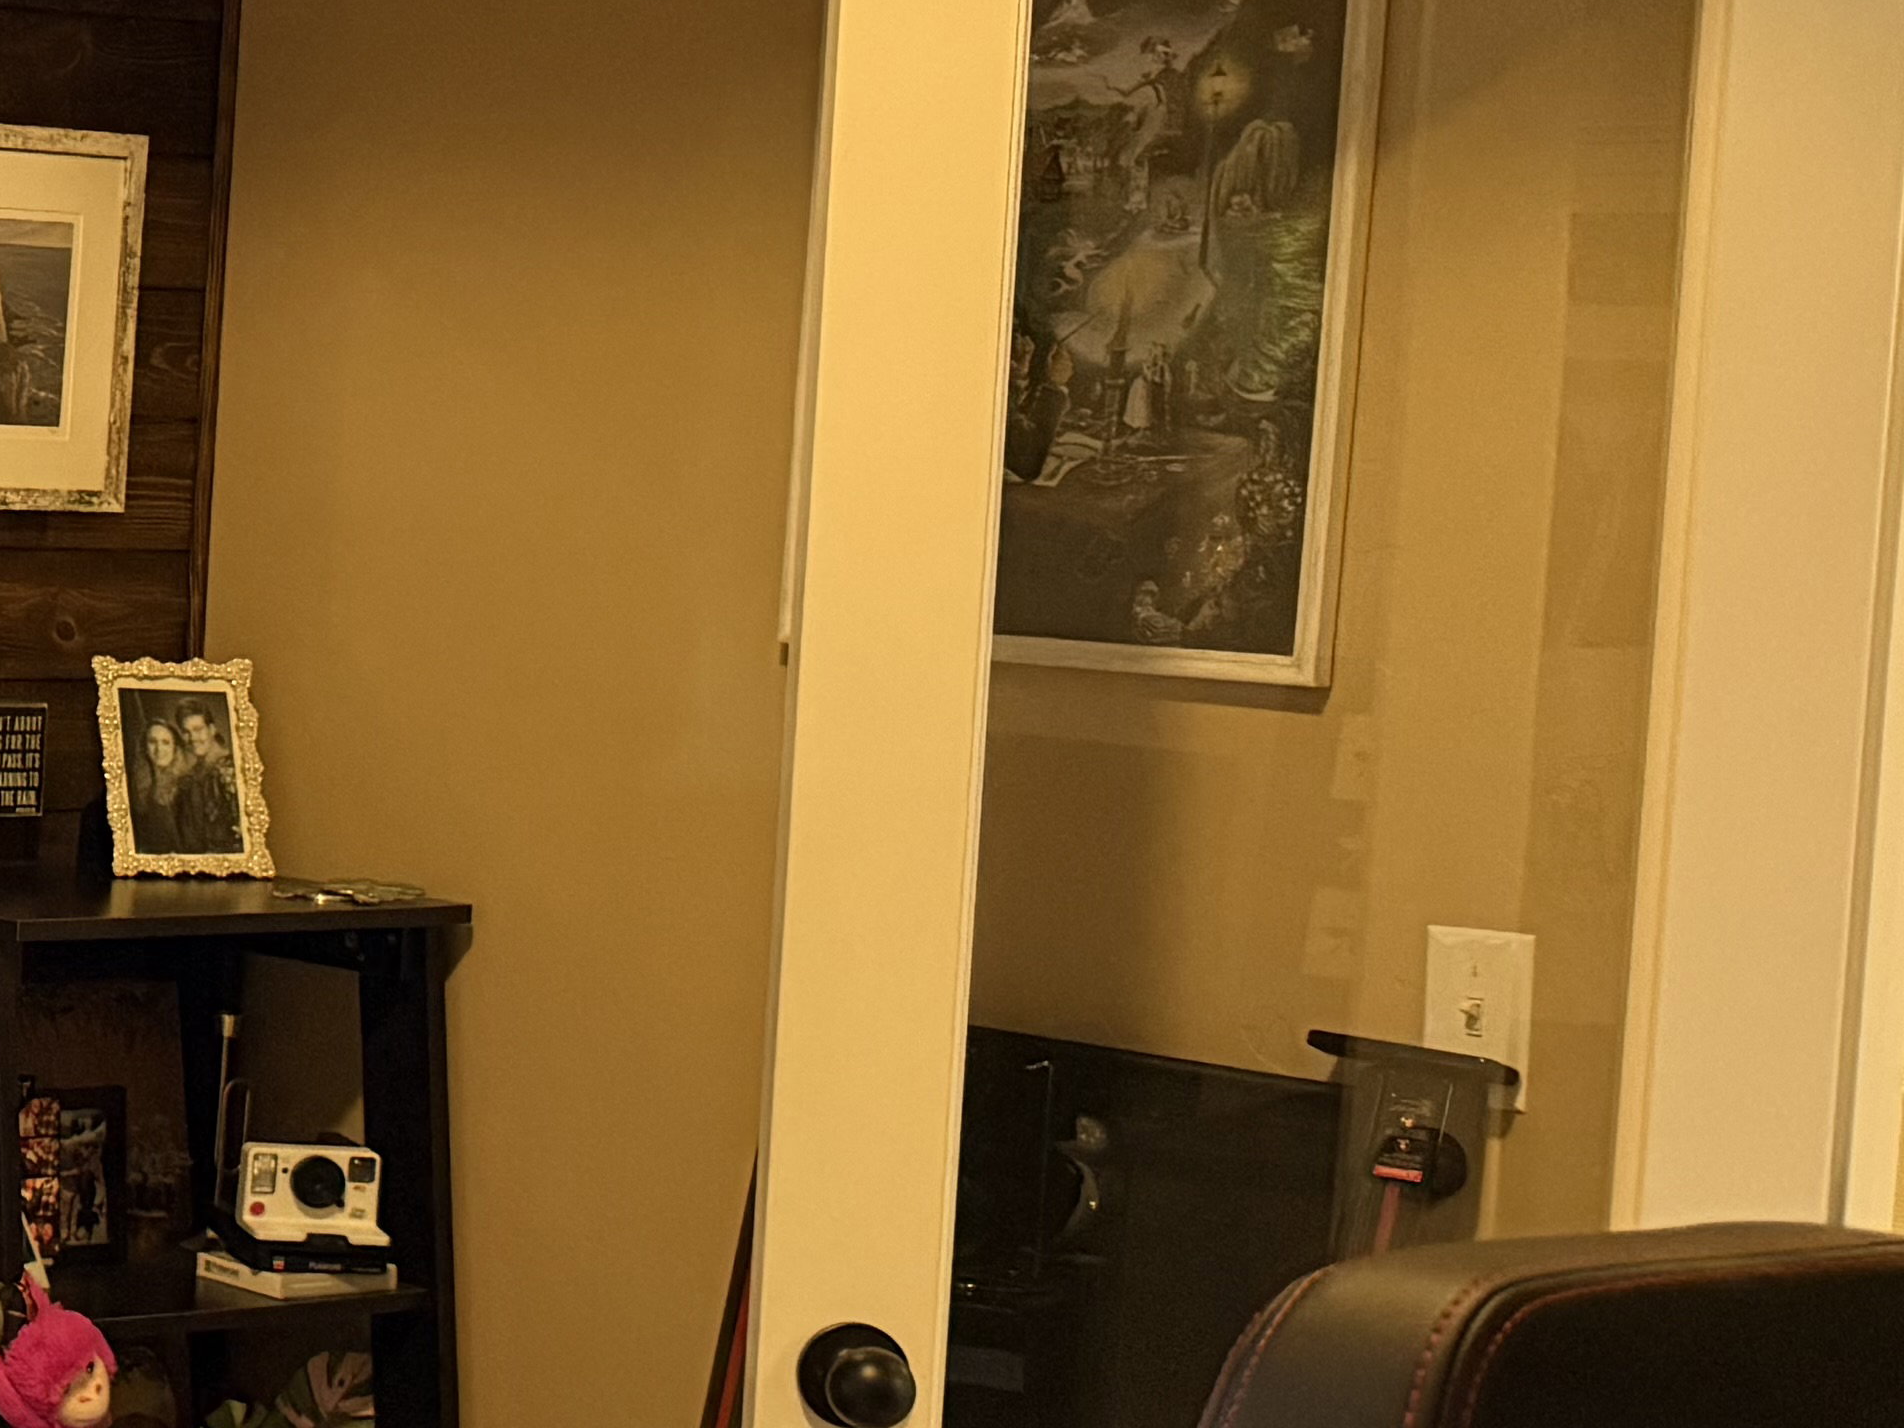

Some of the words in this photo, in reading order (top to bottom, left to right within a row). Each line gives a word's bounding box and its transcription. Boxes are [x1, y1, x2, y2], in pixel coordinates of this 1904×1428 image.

[14, 715, 43, 732] ABOUT
[5, 733, 23, 751] FOR
[25, 733, 42, 751] THE
[29, 771, 40, 788] TO
[0, 789, 15, 807] THE
